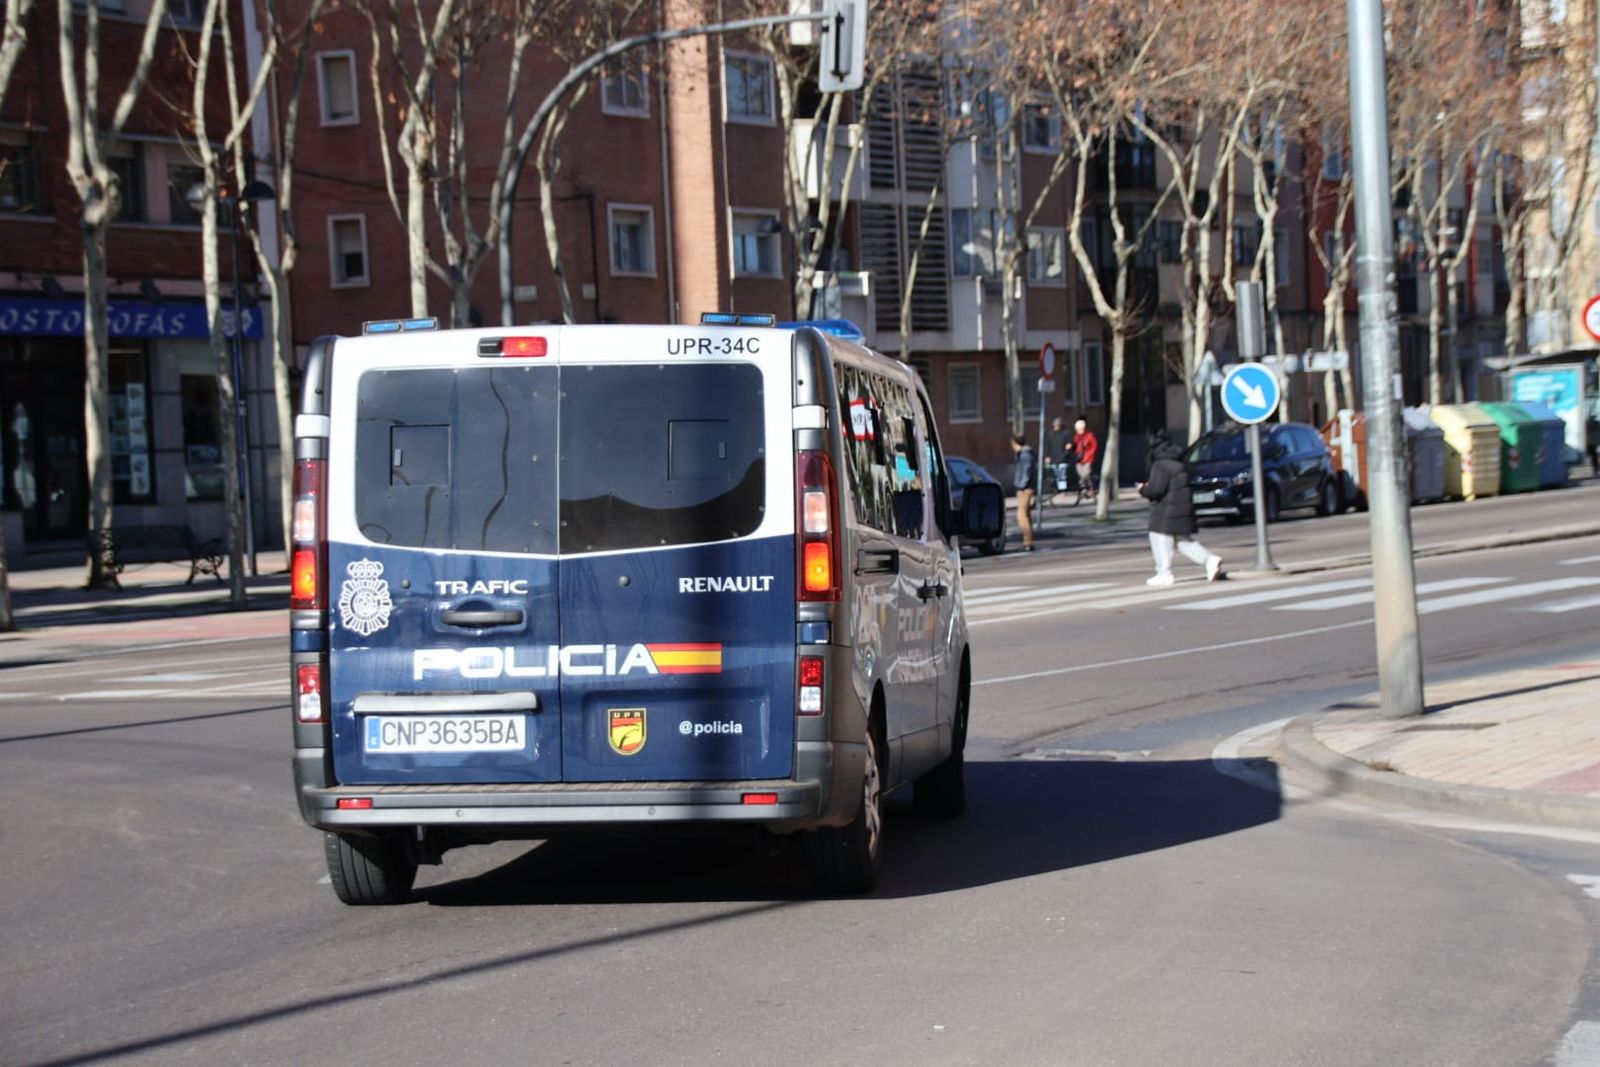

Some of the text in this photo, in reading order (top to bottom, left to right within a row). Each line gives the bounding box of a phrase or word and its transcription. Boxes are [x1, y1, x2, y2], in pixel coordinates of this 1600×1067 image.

[105, 306, 187, 335] OFÁS
[667, 337, 761, 356] UPR-34C
[435, 579, 529, 595] TRAFIC
[678, 575, 775, 594] RENAULT
[381, 719, 520, 746] CNP3635BA
[678, 720, 744, 737] @policia
